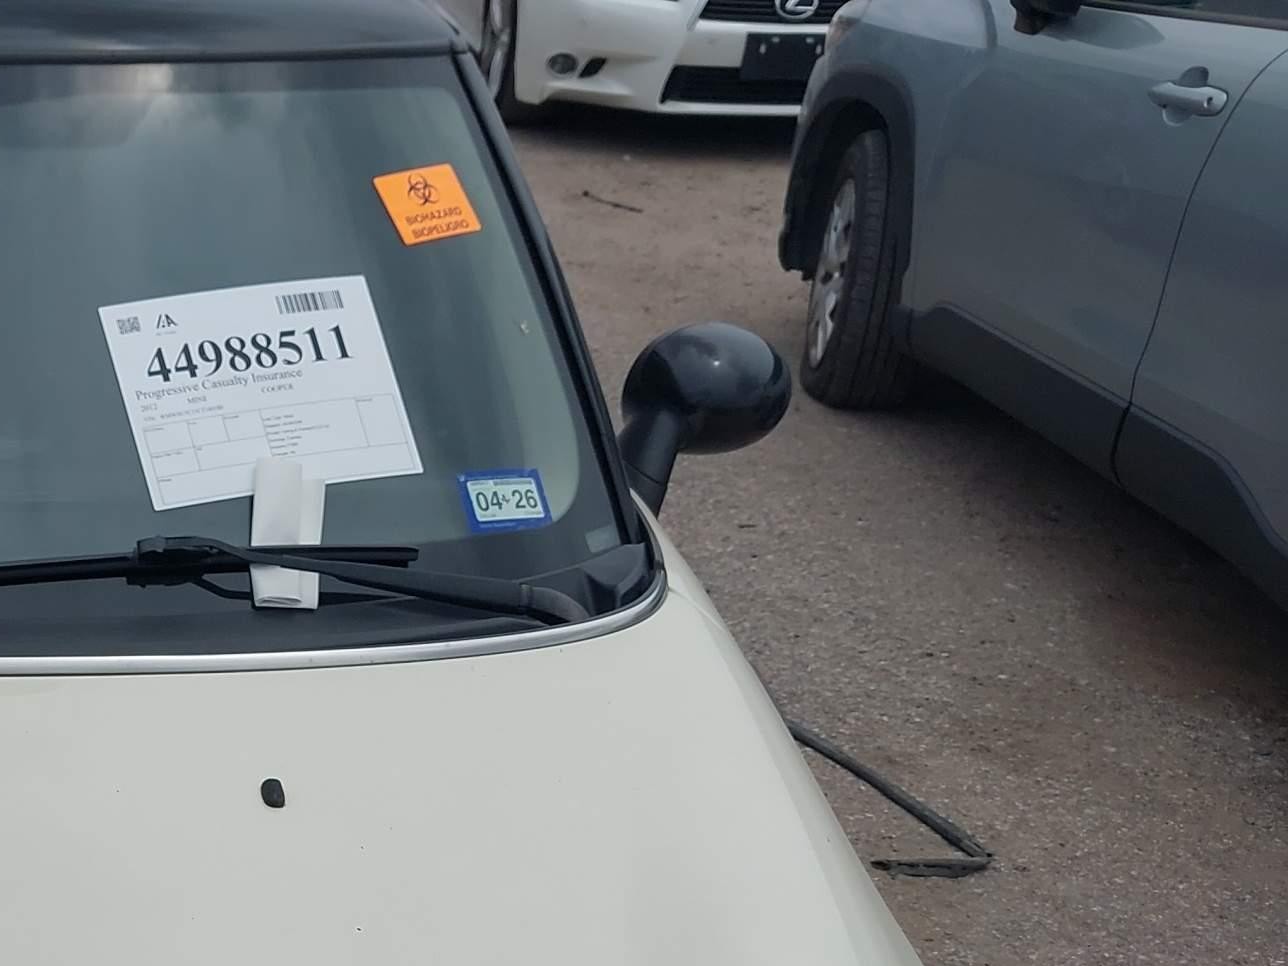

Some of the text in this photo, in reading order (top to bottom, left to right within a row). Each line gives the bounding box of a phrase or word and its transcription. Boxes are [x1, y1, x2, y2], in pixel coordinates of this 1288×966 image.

[405, 207, 462, 225] BIOHAZARD
[411, 219, 470, 239] BIOPELIGRO
[147, 324, 354, 382] 44988511
[135, 369, 303, 401] Progressive Casualty Insurance
[475, 488, 538, 512] 04 26
